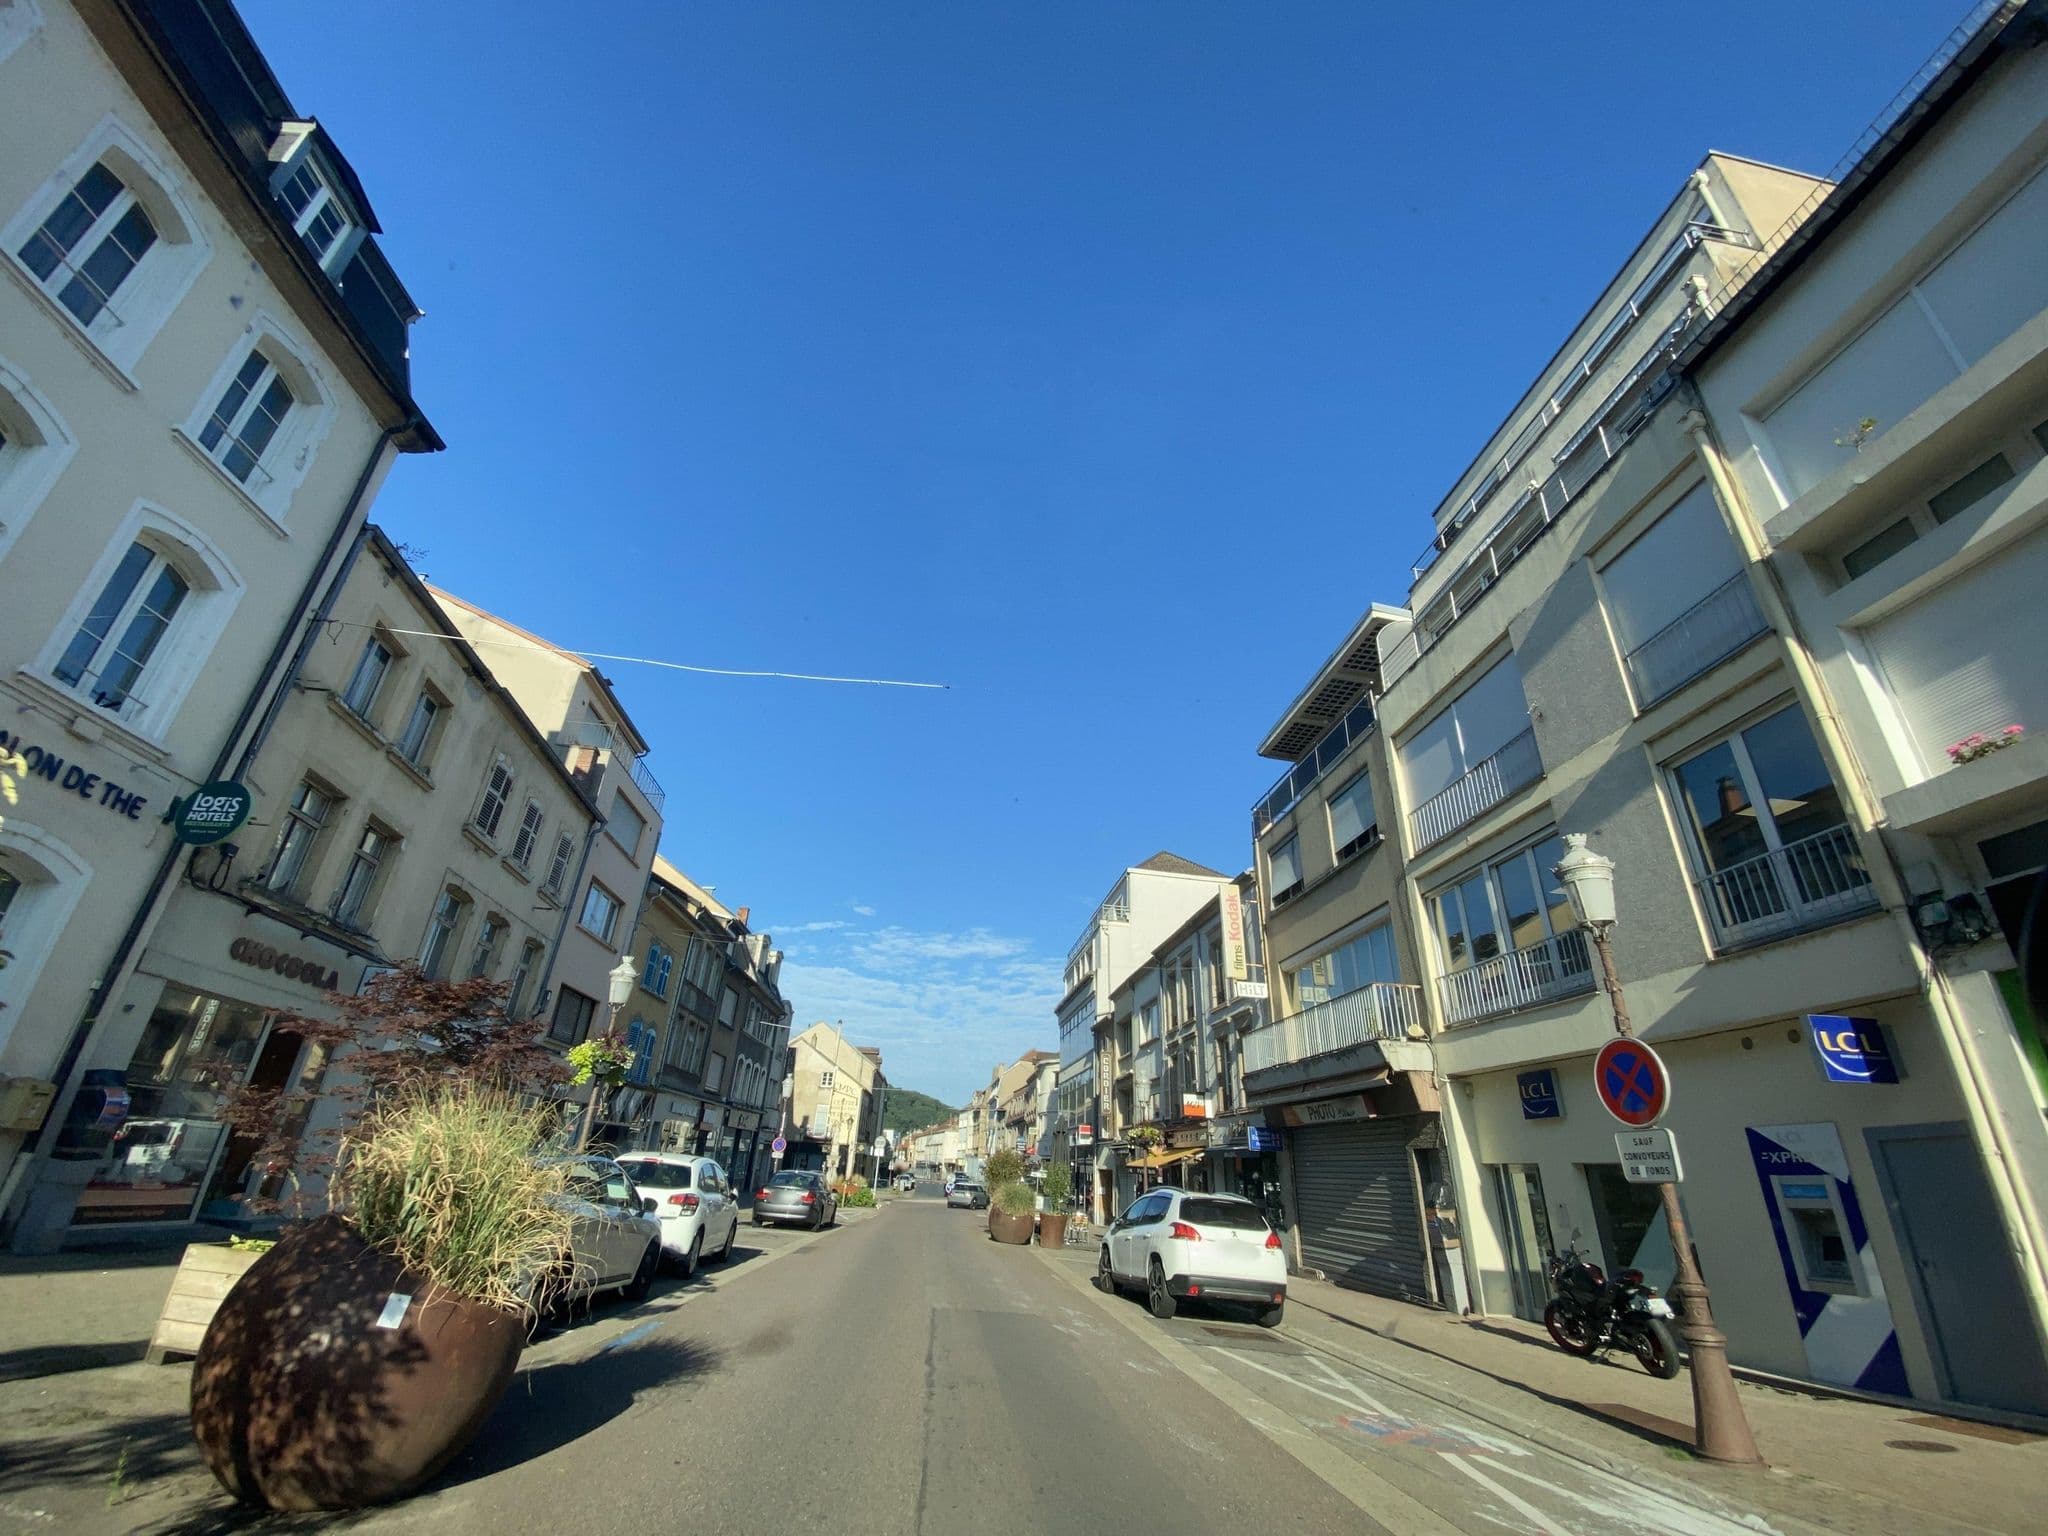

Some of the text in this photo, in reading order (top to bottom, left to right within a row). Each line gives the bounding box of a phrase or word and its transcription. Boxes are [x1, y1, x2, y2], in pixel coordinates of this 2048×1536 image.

[62, 765, 101, 799] DE
[100, 782, 148, 820] THE
[186, 811, 236, 822] HOTELS
[1226, 895, 1241, 941] Kodak
[1233, 945, 1245, 971] films
[1820, 1031, 1880, 1053] LCL
[1521, 1083, 1552, 1099] LCL
[1306, 1103, 1336, 1121] PHOTO
[1633, 1137, 1653, 1146] SAUF
[1624, 1151, 1671, 1161] CONVOYEURS
[1630, 1166, 1671, 1175] DE FONDS
